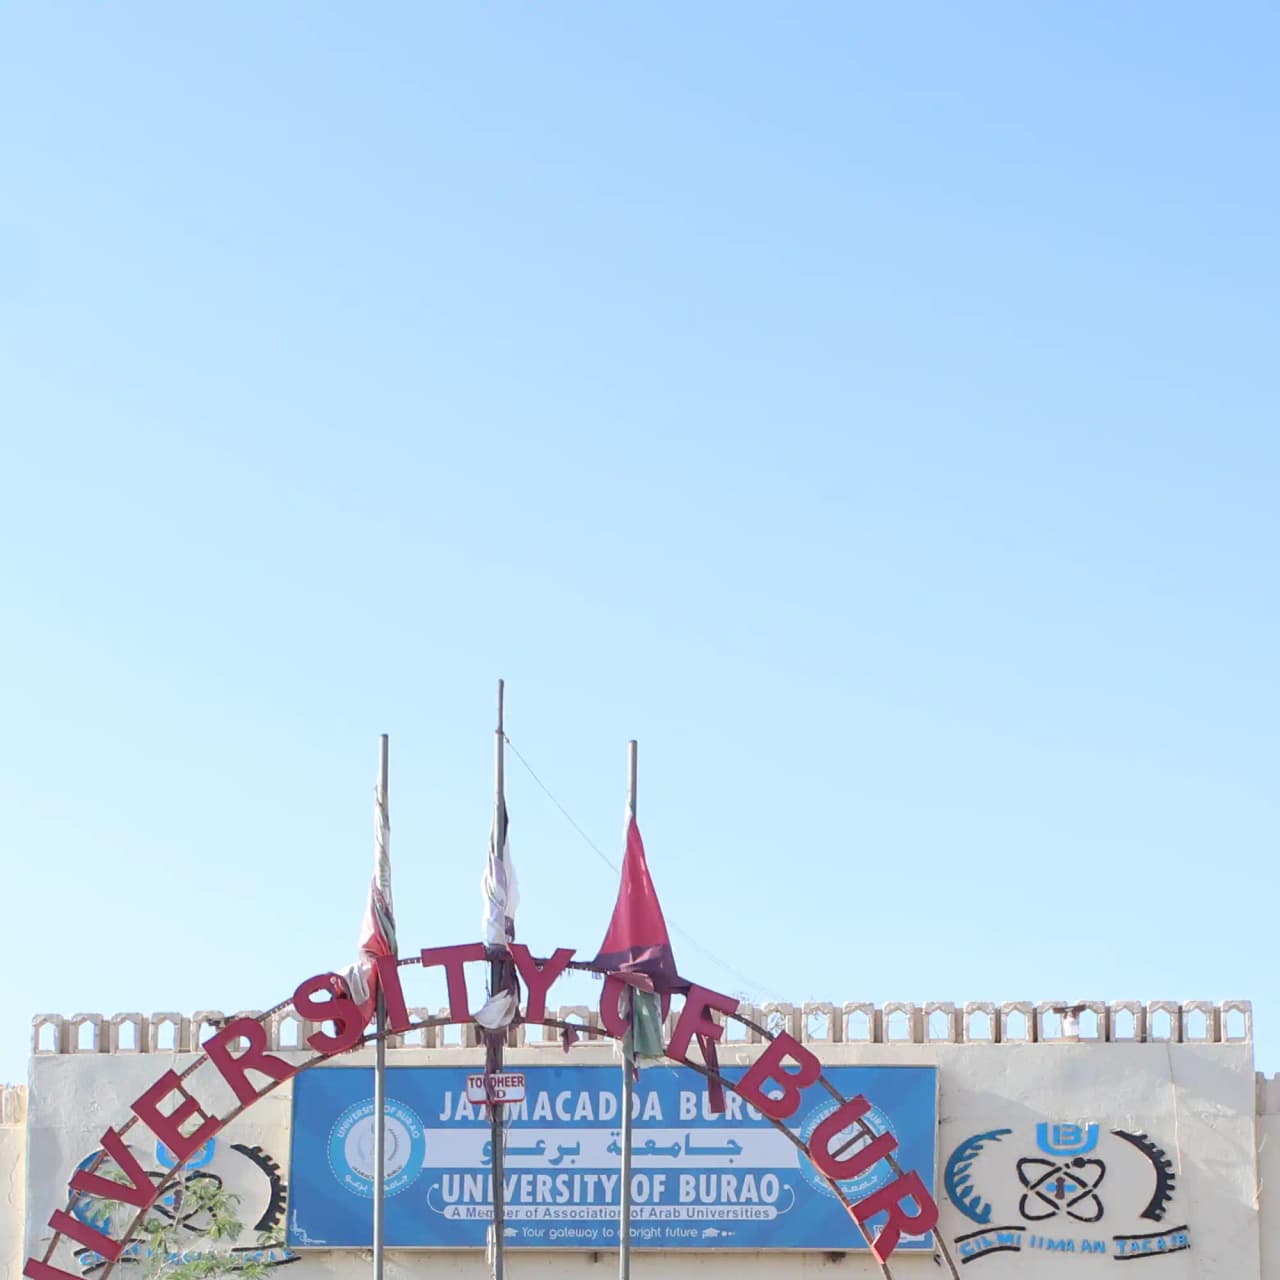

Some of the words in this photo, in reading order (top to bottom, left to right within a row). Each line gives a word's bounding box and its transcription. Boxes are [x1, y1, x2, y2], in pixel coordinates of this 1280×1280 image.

[468, 1076, 525, 1089] TODHEER
[441, 1173, 620, 1204] UNIVERSITY
[630, 1173, 667, 1204] OF
[679, 1173, 780, 1204] BURAO
[451, 1207, 461, 1218] A
[465, 1207, 520, 1218] Memer
[525, 1207, 539, 1218] of
[630, 1207, 644, 1218] of
[648, 1207, 681, 1218] Arab
[686, 1207, 770, 1218] Universities
[521, 1227, 546, 1238] Your
[548, 1227, 598, 1240] gateway
[601, 1227, 614, 1238] to
[629, 1226, 662, 1240] bright
[665, 1226, 698, 1238] future
